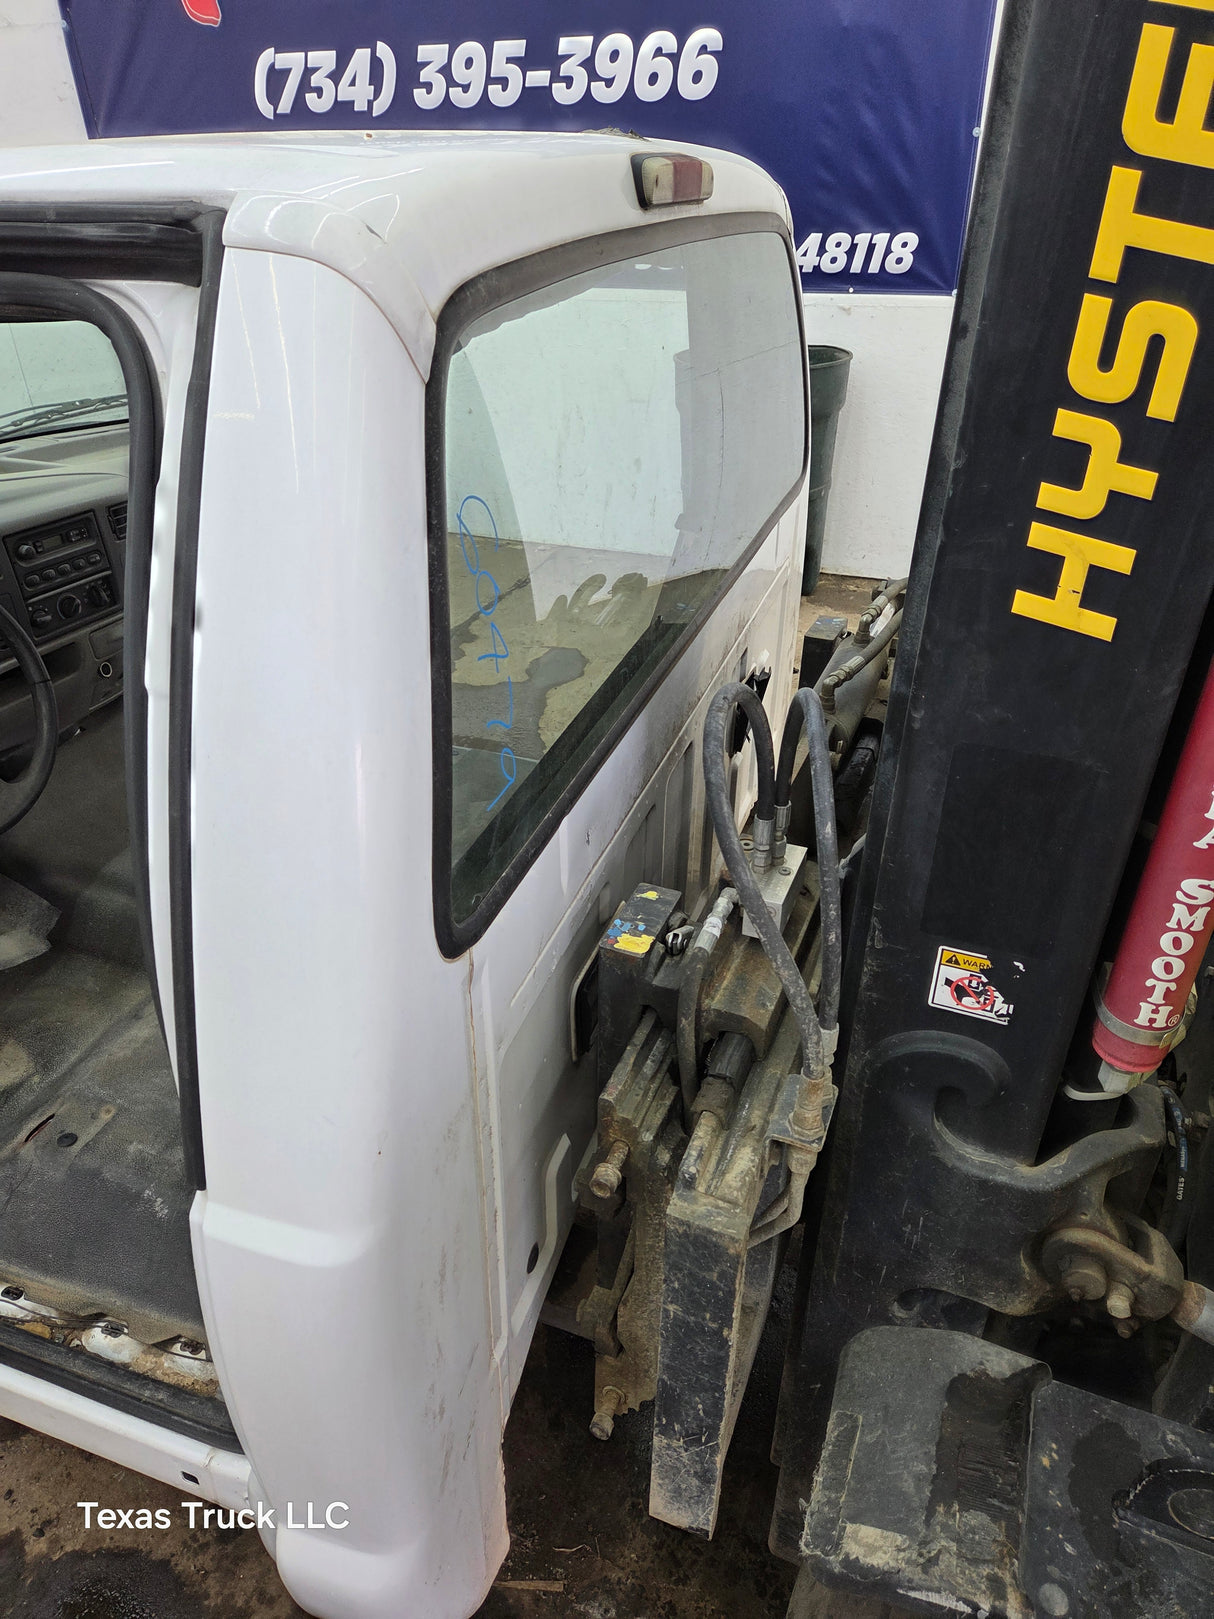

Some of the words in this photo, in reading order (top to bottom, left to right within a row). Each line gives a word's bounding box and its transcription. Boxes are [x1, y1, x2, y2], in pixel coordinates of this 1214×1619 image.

[254, 41, 397, 120] (734)
[413, 28, 724, 110] 395-3966
[796, 232, 919, 274] 48118
[1011, 0, 1214, 642] HYSTE
[1176, 1177, 1185, 1201] GATES
